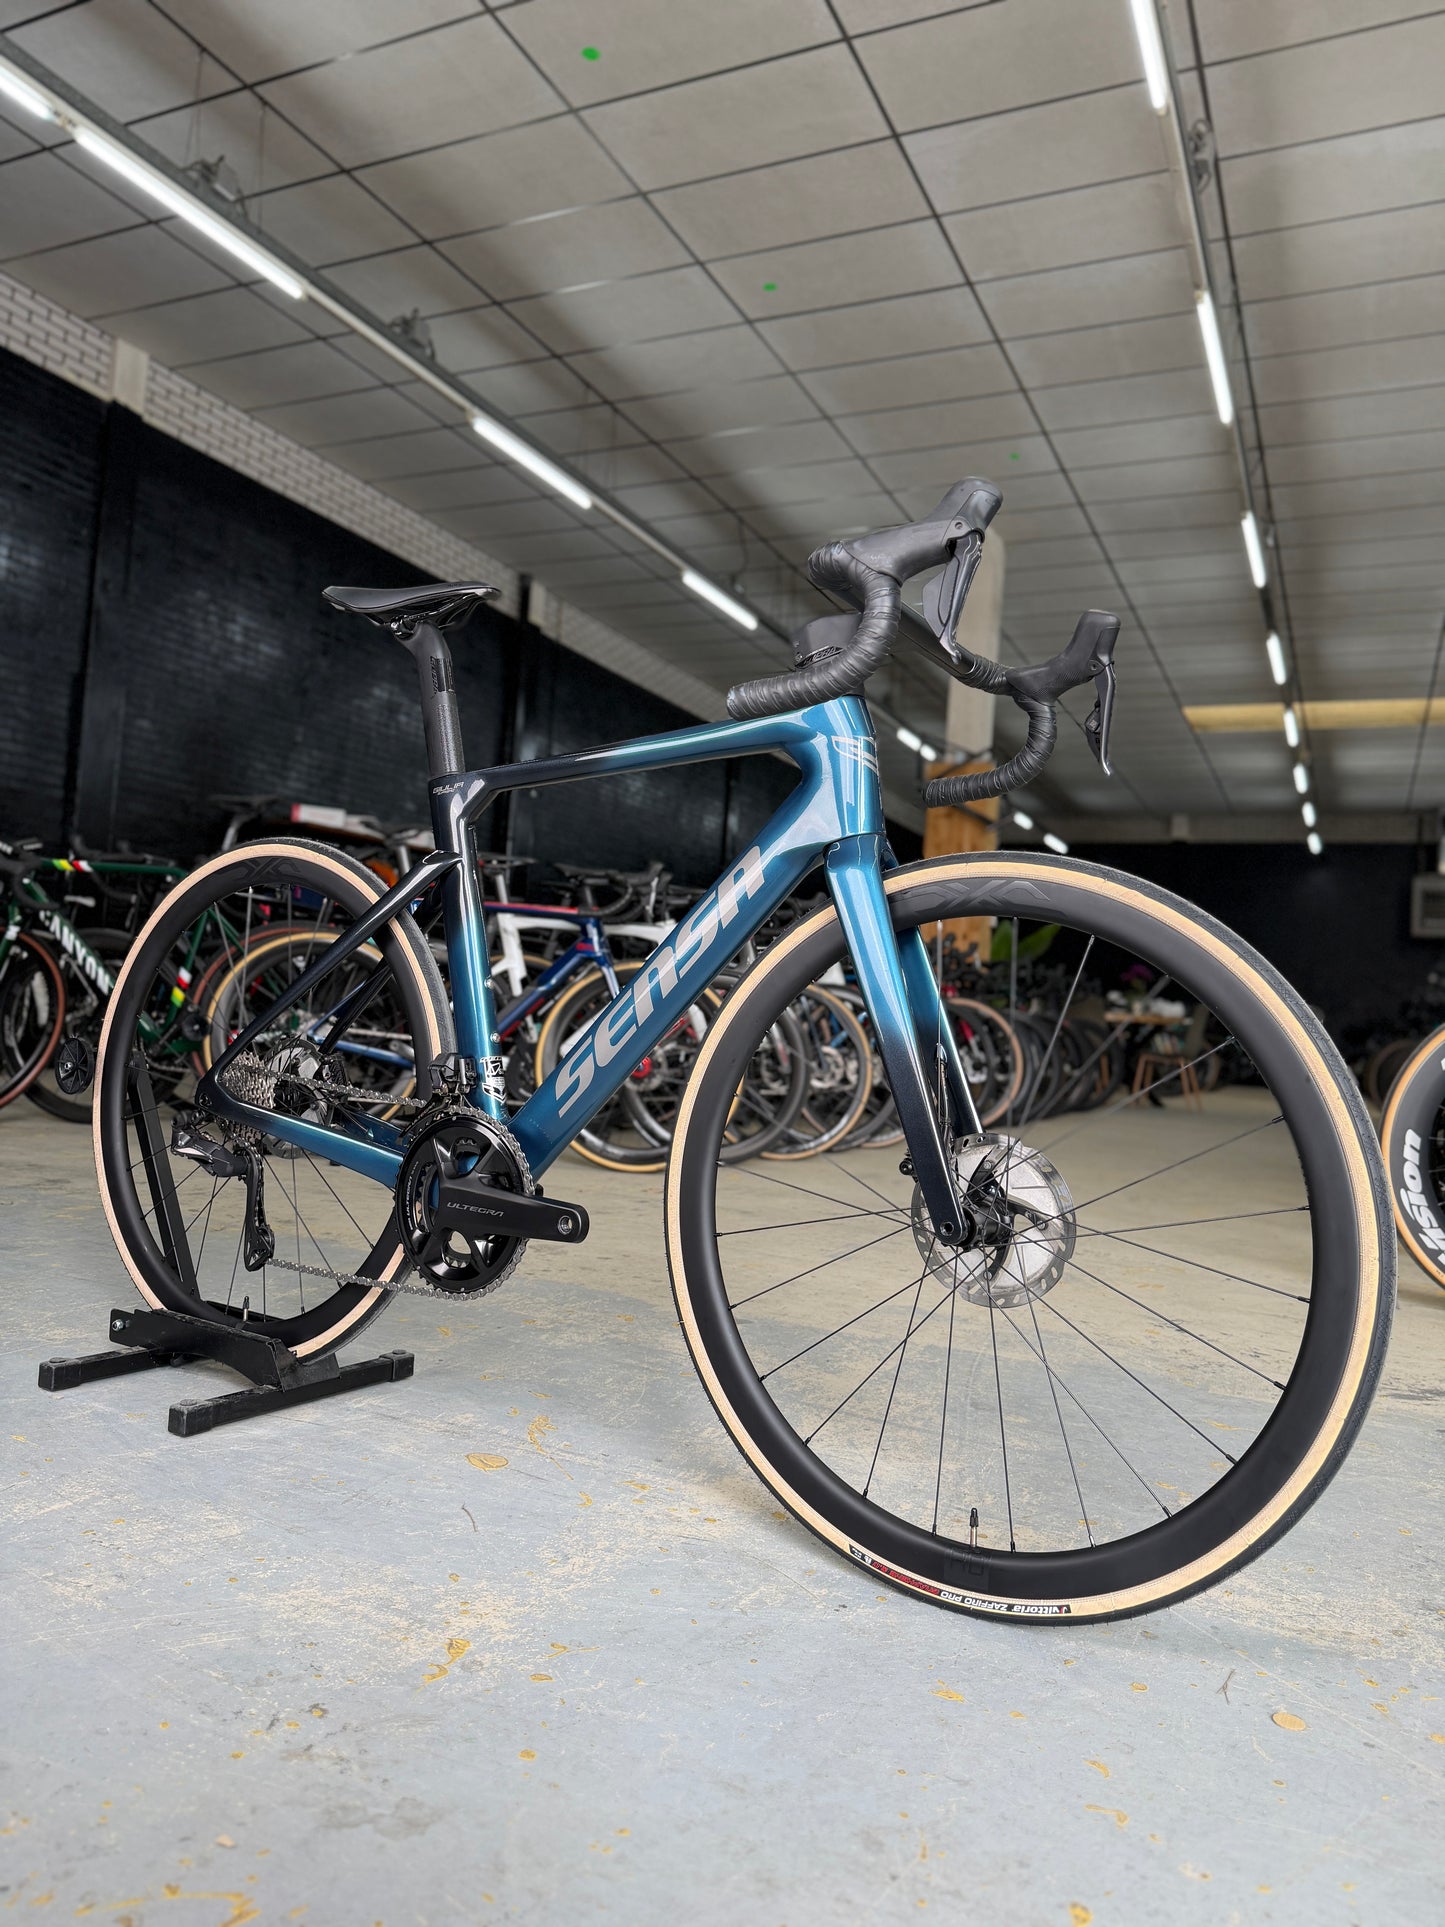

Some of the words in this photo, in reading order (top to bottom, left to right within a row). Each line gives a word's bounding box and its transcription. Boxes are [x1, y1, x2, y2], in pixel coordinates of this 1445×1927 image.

[39, 908, 111, 996] CANYON
[555, 845, 767, 1117] SENSA
[1400, 1127, 1445, 1267] ision
[446, 1201, 505, 1218] ULTEGRA
[940, 1590, 963, 1604] PRO
[964, 1597, 1009, 1612] ZAFFIRO
[1013, 1604, 1060, 1615] vittoria
